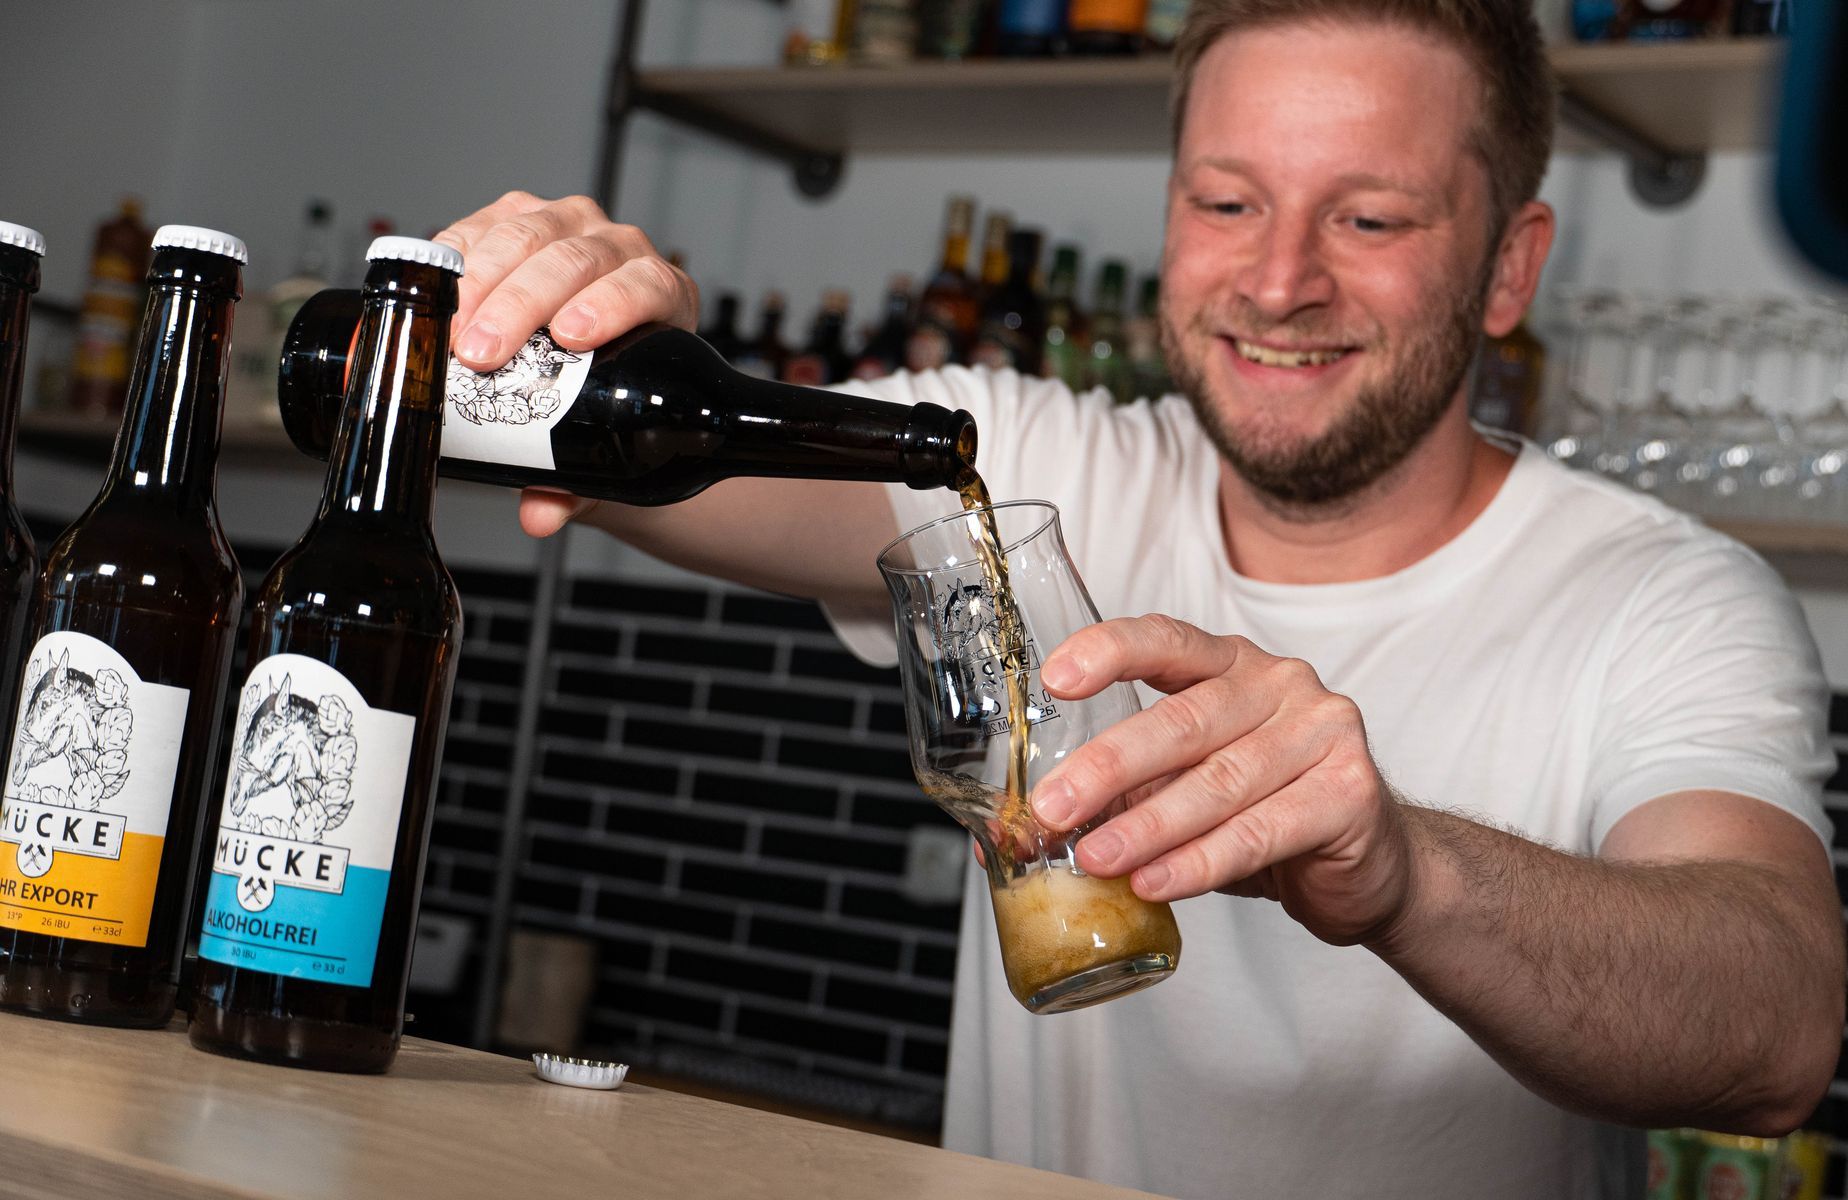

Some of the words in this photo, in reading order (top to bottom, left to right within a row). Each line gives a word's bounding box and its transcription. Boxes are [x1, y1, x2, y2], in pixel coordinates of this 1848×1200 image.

[217, 836, 333, 881] MÜCKE
[21, 882, 99, 910] EXPORT
[41, 917, 52, 927] 26
[54, 919, 71, 929] IBU
[103, 926, 122, 937] 33cl
[206, 908, 318, 946] ALKOHOLFREI
[242, 948, 257, 960] IBU
[323, 963, 336, 974] 33
[337, 964, 346, 975] cl
